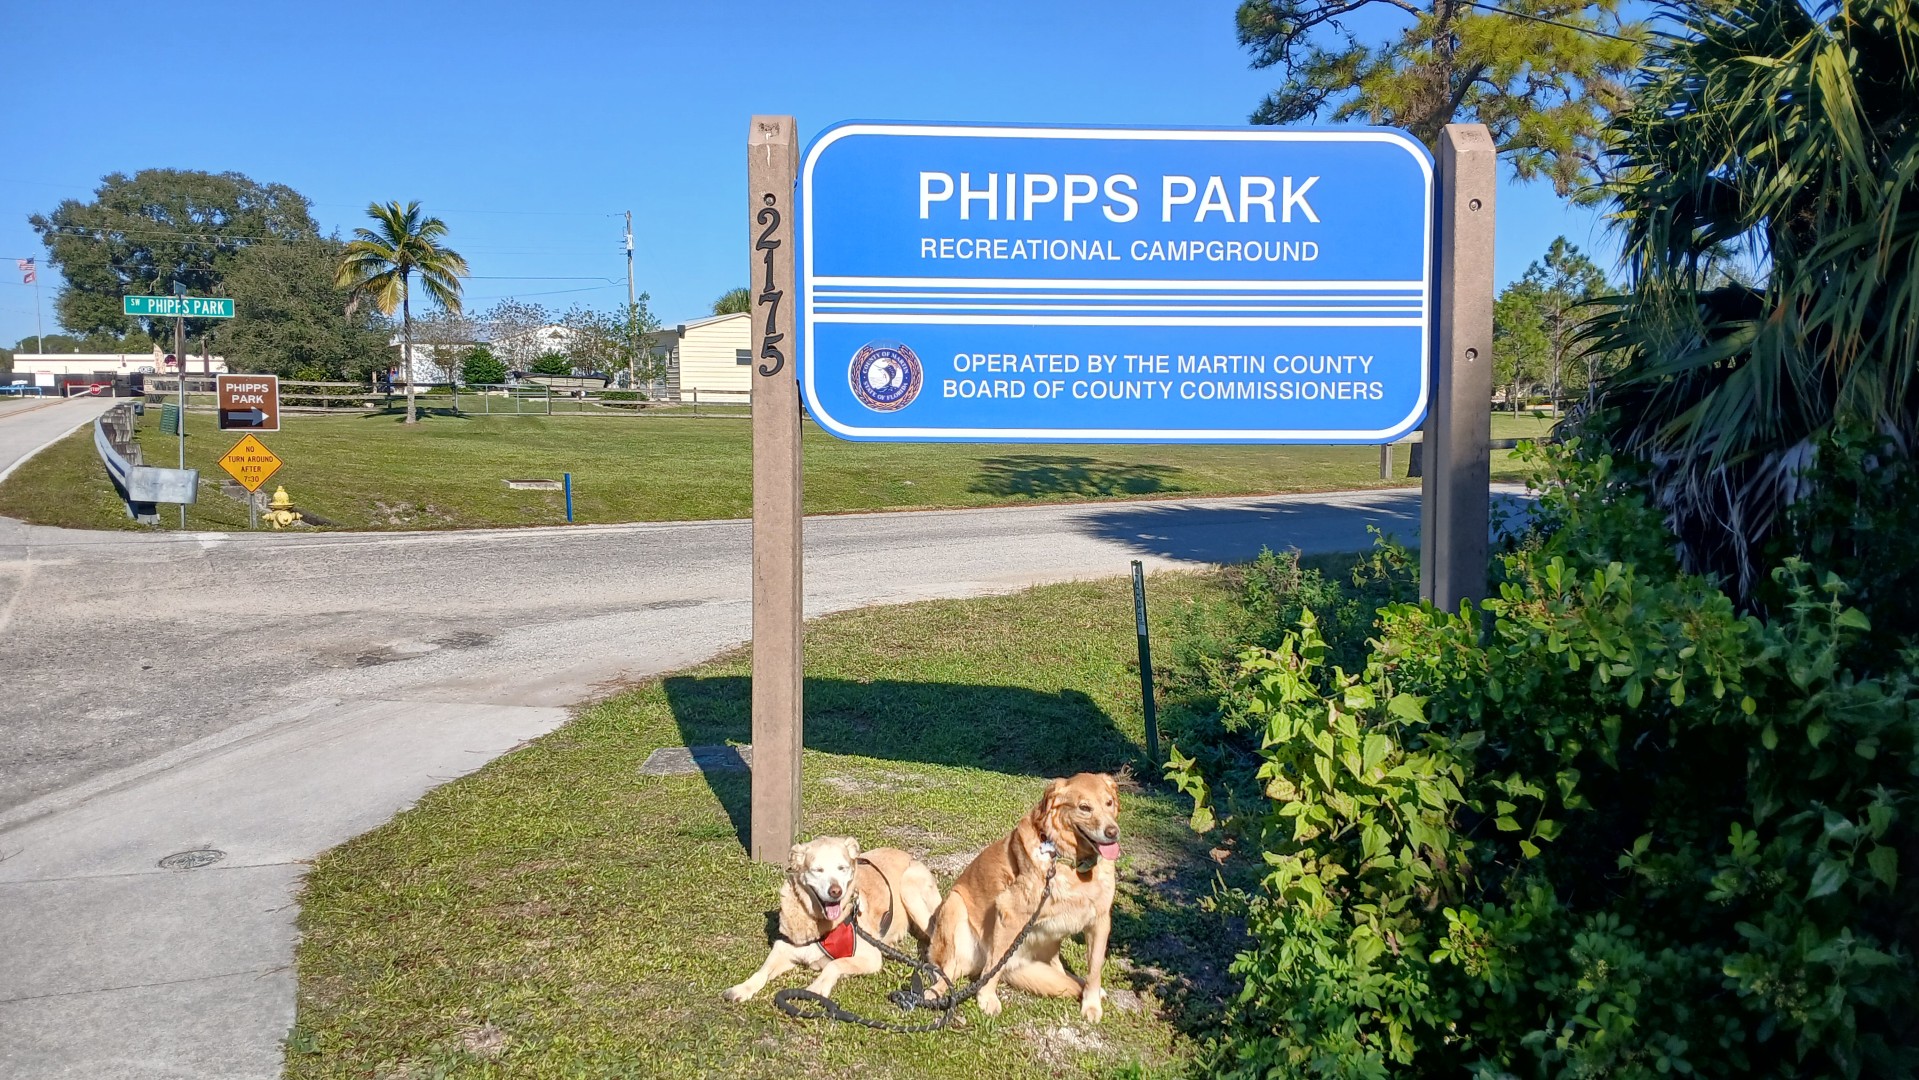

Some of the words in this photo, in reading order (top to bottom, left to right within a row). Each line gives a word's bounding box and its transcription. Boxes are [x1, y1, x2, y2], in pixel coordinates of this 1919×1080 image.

[919, 171, 1139, 224] PHIPPS
[1162, 175, 1322, 224] PARK
[920, 237, 1121, 262] RECREATIONAL
[1130, 240, 1320, 263] CAMPGROUND
[756, 207, 785, 377] 2175
[130, 298, 141, 306] SW
[148, 298, 190, 314] PHIPPS
[193, 300, 225, 315] PARK
[862, 352, 881, 374] COUNTY
[891, 353, 910, 374] MARTIN
[953, 353, 1080, 374] OPERATED
[1087, 354, 1118, 374] BY
[1123, 354, 1171, 374] THE
[1177, 354, 1265, 374] MARTIN
[1272, 354, 1375, 375] COUNTY
[225, 383, 269, 393] PHIPPS
[863, 381, 878, 398] STATE
[886, 382, 909, 401] FLORIDA
[943, 379, 1026, 399] BOARD
[1033, 379, 1066, 400] OF
[1072, 379, 1174, 400] COUNTY
[1180, 380, 1384, 400] COMMISSIONERS
[231, 394, 264, 404] PARK
[228, 455, 245, 463] TURN
[247, 455, 274, 463] AROUND
[243, 475, 260, 483] 7:30
